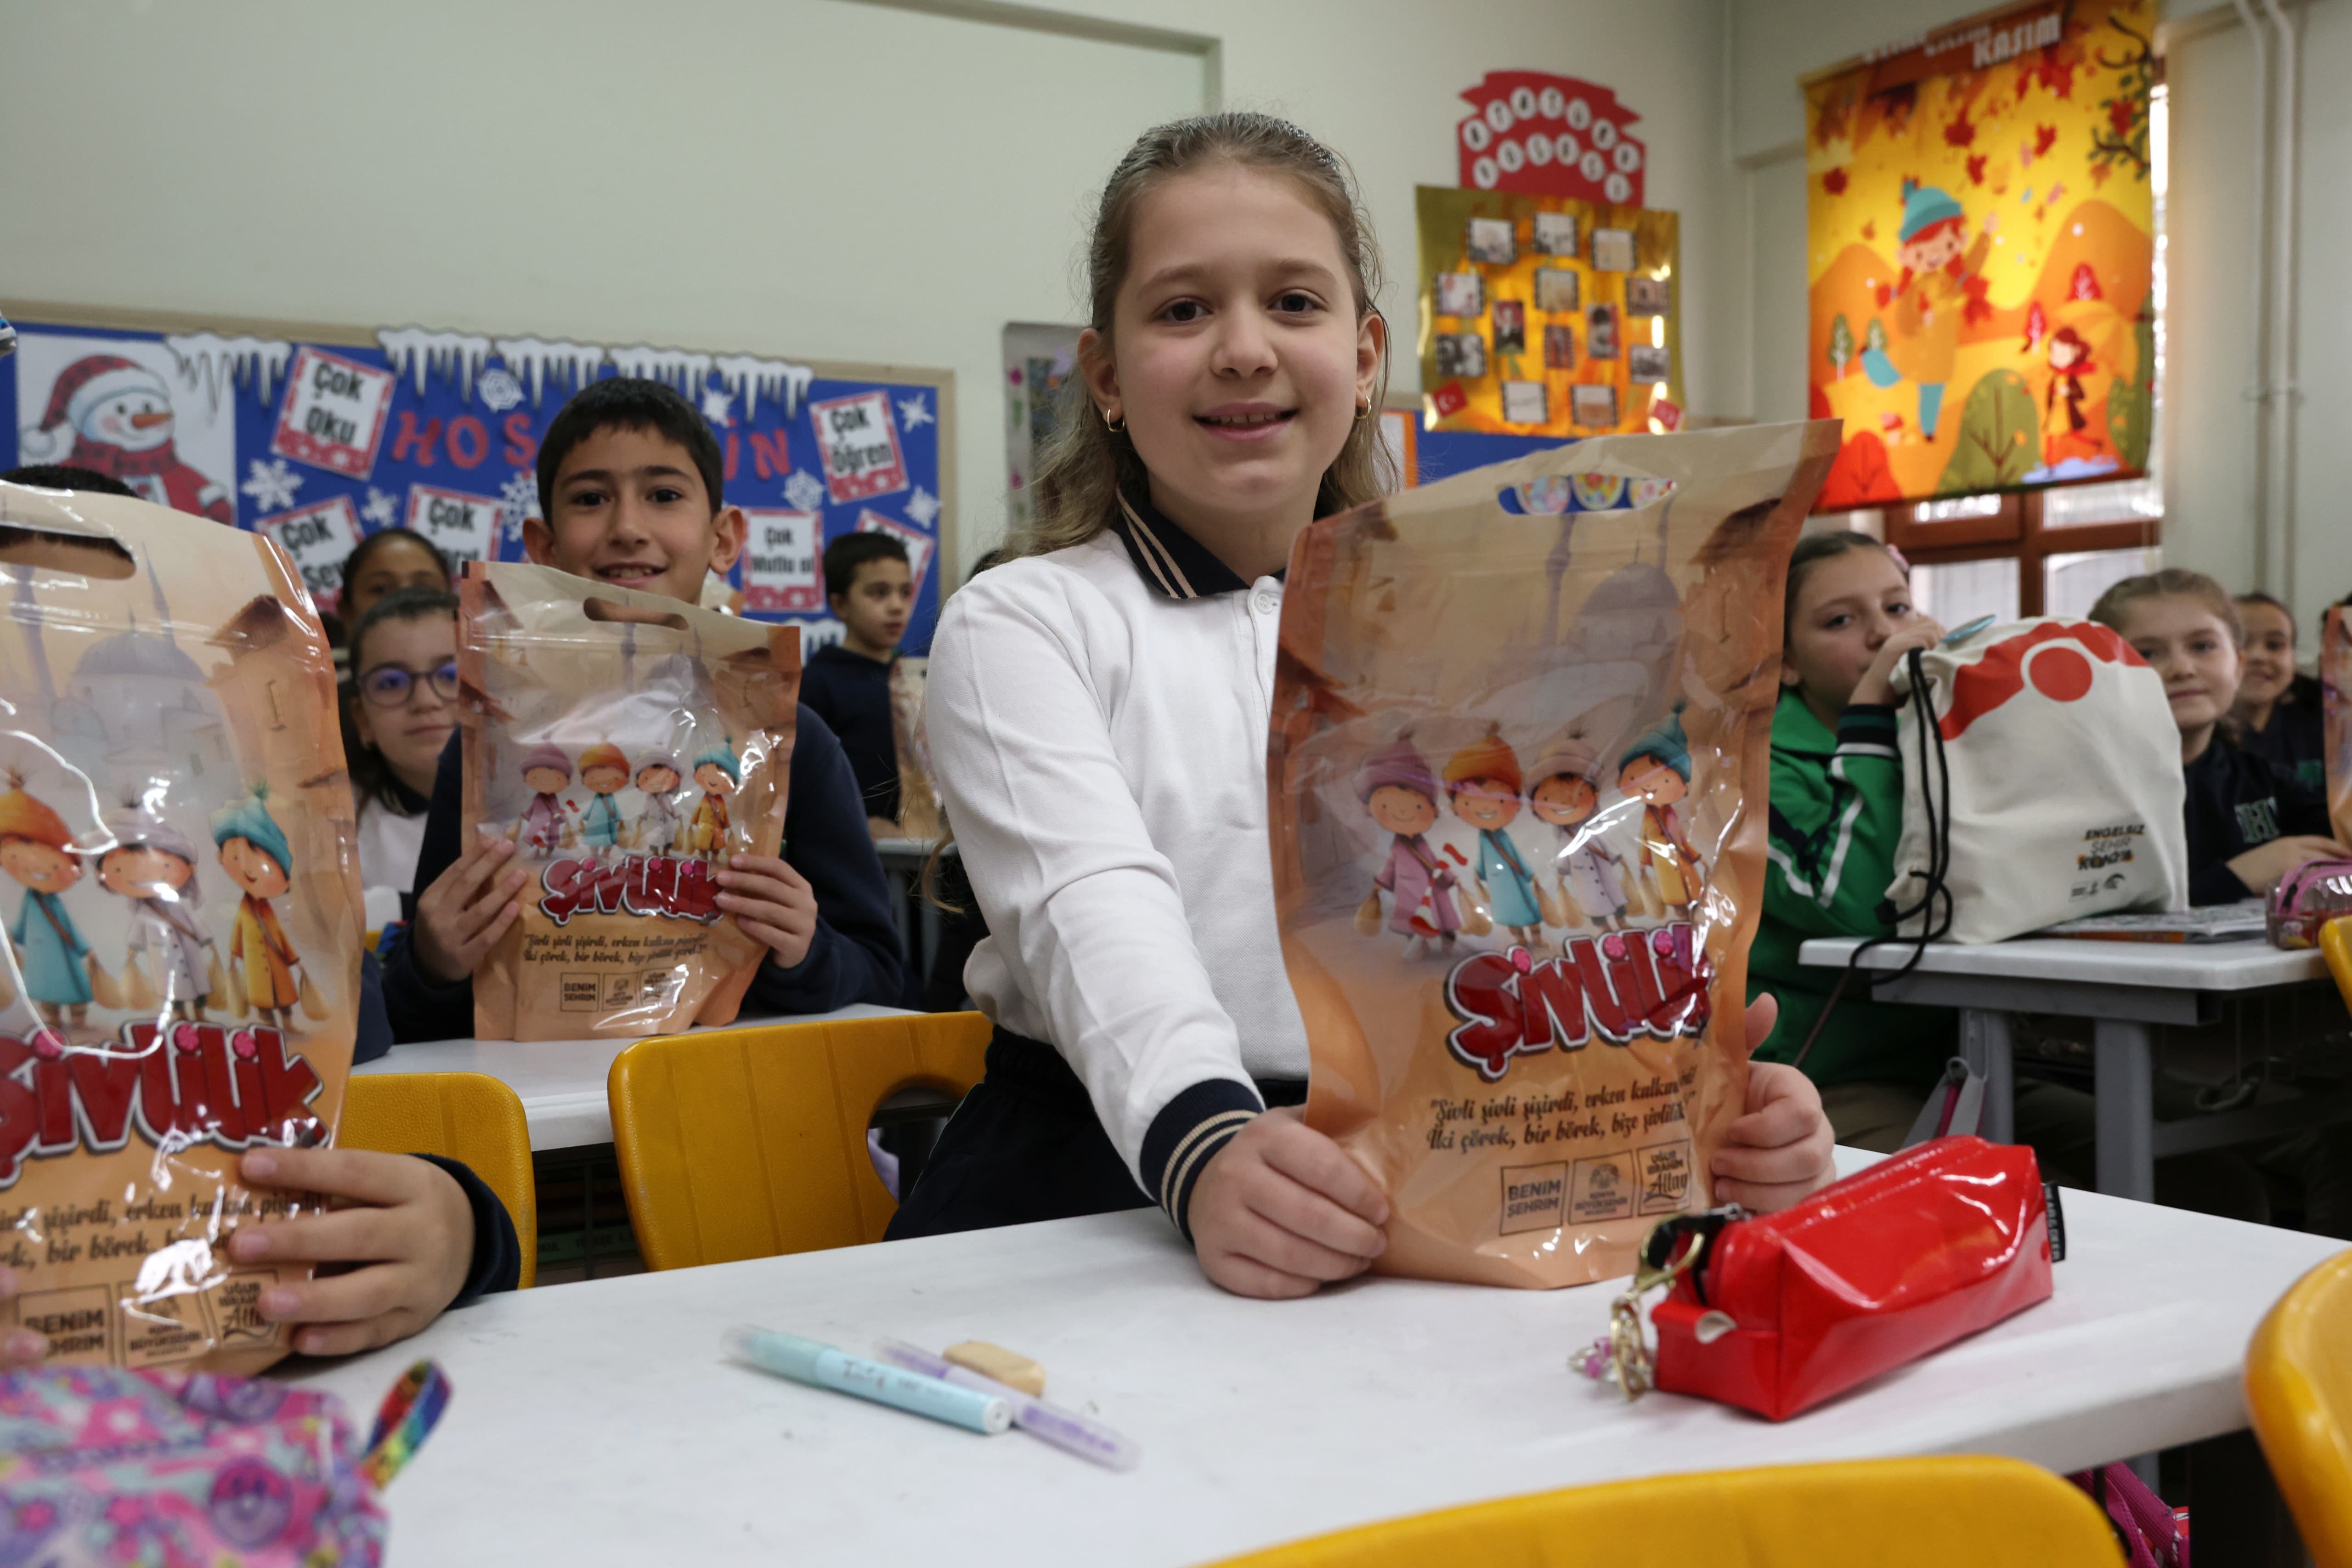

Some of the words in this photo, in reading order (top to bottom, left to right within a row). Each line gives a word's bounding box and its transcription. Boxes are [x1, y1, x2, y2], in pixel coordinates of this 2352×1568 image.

[314, 362, 365, 401] Çok
[305, 406, 357, 445] Oku
[391, 409, 538, 479] HOŞ
[428, 498, 477, 535] Çok
[280, 515, 334, 560] Çok
[1481, 1095, 1517, 1125] şivli
[1585, 1085, 1625, 1108] erken
[1524, 1123, 1551, 1144] bir
[1555, 1115, 1605, 1141] börek,
[47, 1239, 81, 1264] bir
